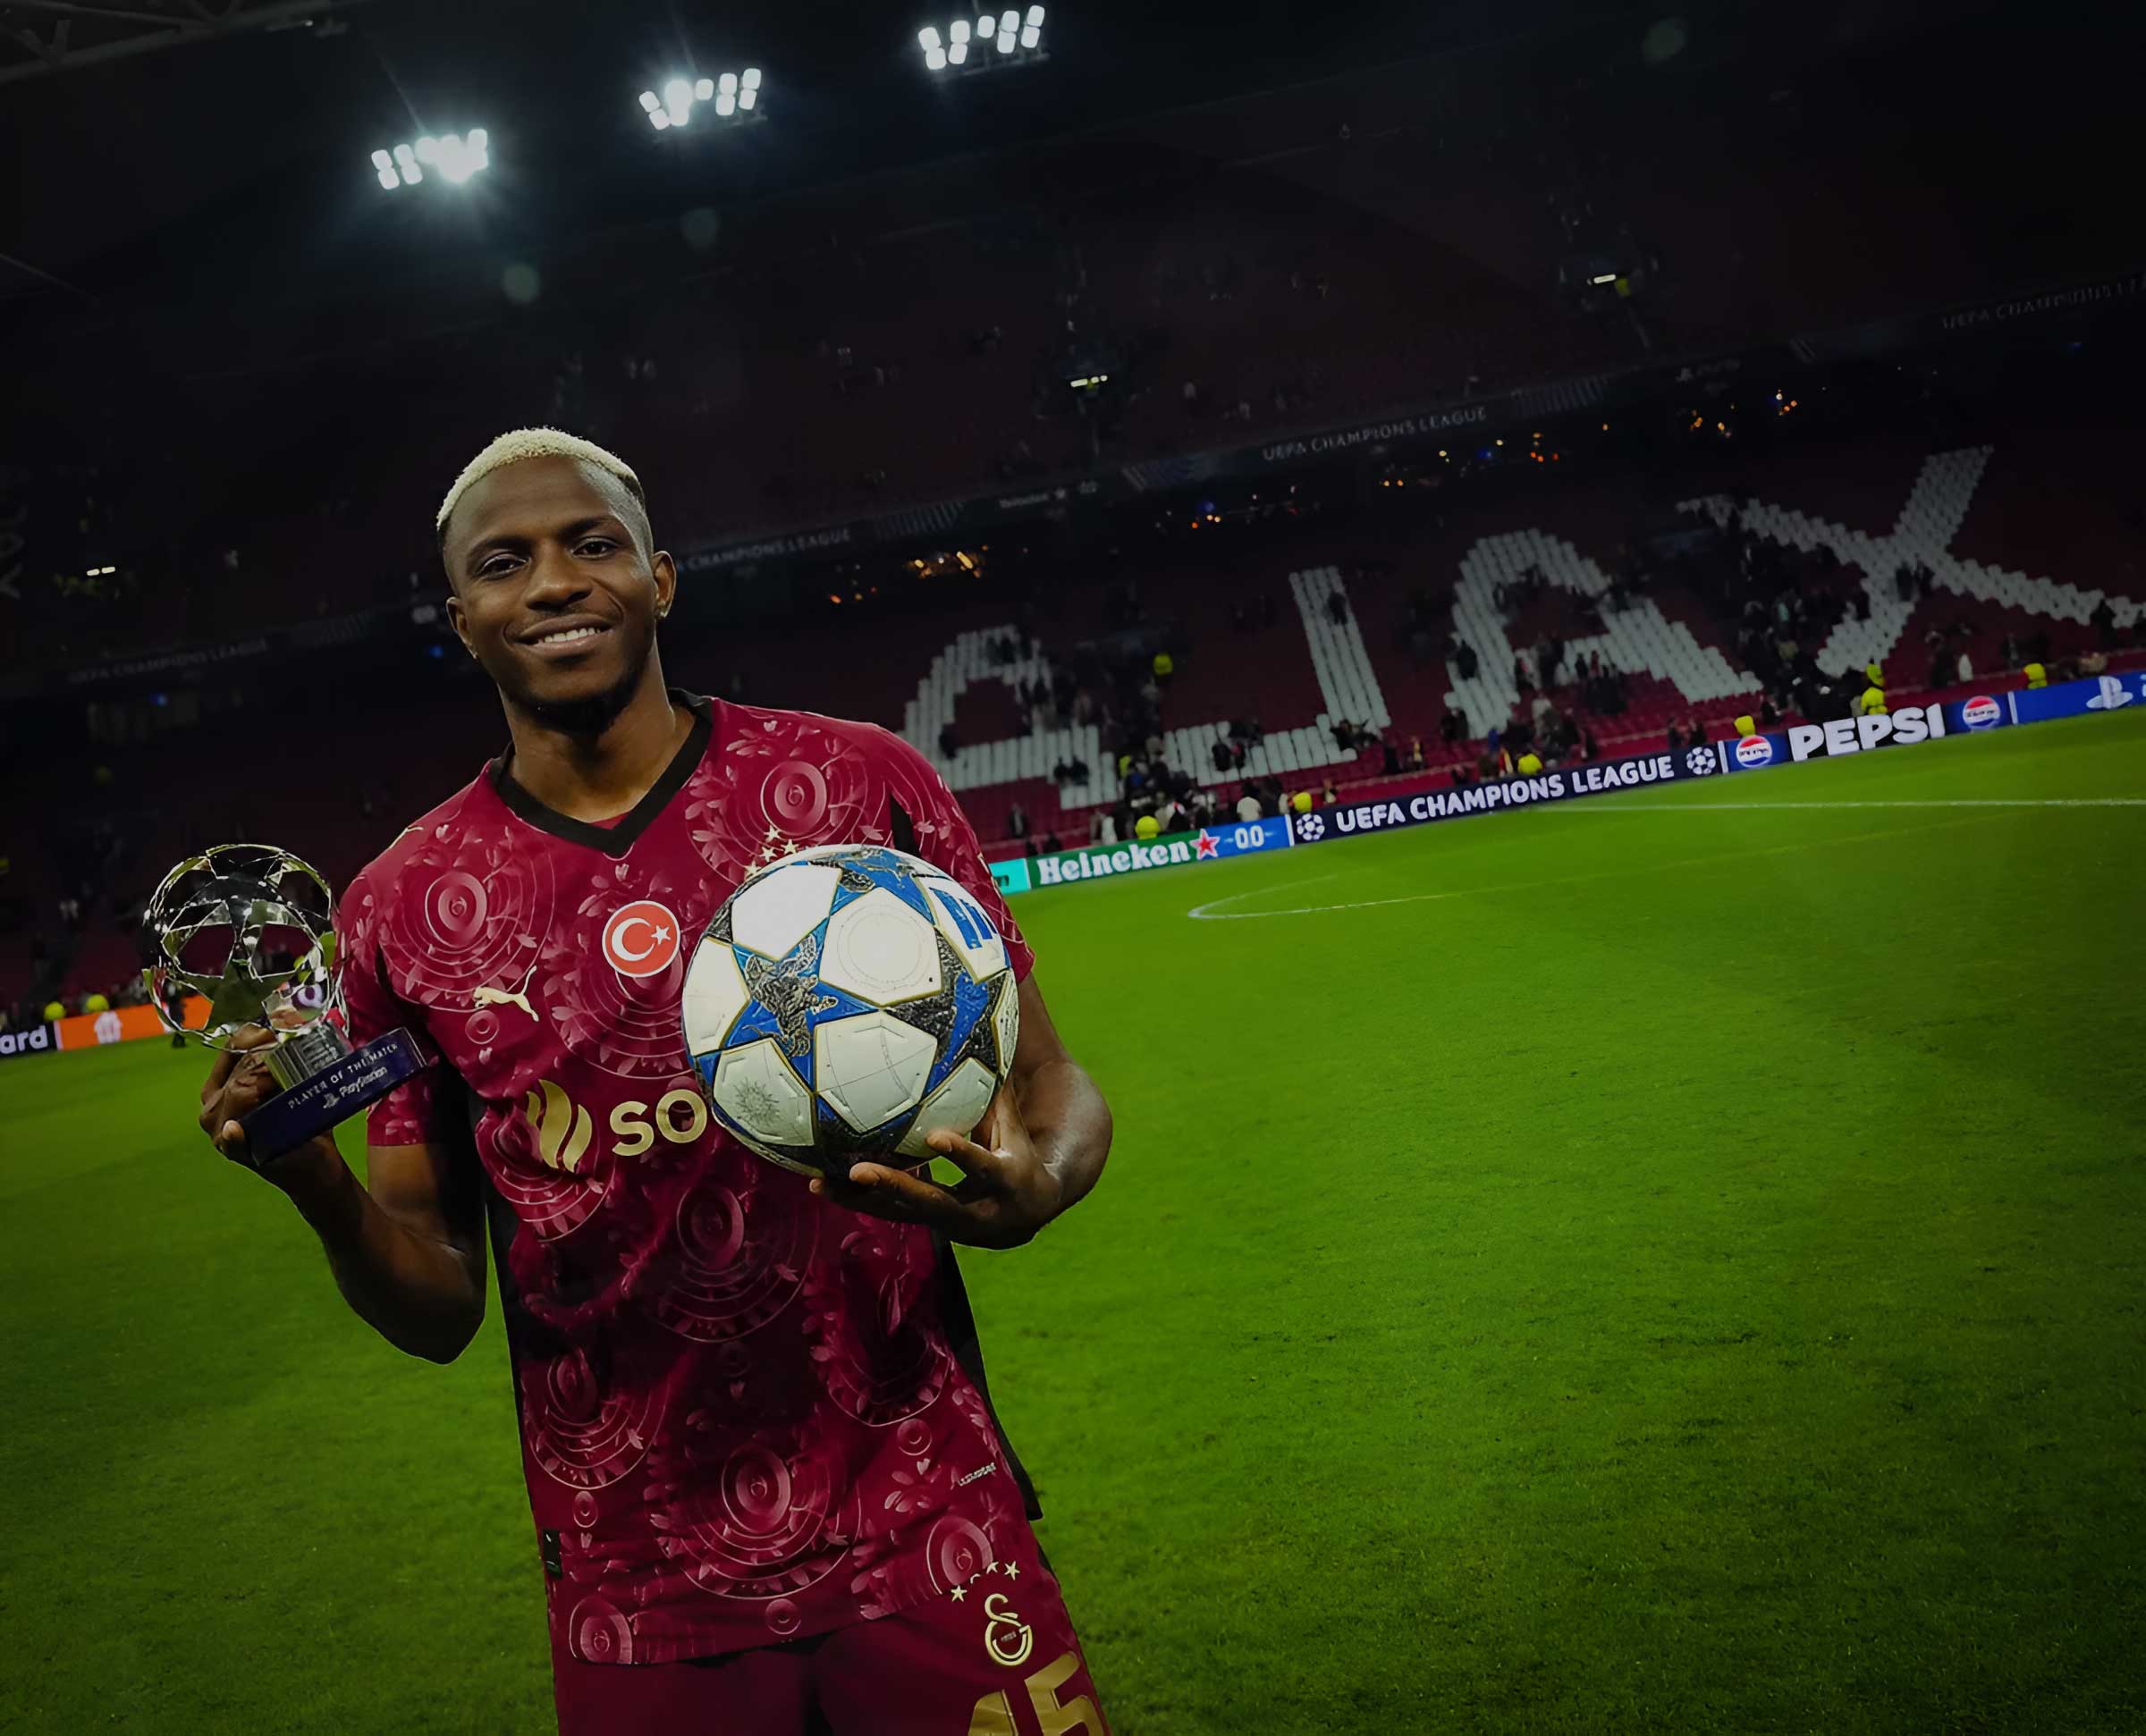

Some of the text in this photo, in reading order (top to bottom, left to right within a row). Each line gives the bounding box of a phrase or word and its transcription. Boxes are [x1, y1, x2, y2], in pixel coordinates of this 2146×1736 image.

[1263, 405, 1488, 461] UEFA CHAMPIONS LEAGUE
[1787, 702, 1947, 763] PEPSI
[1335, 755, 1675, 833] UEFA CHAMPIONS LEAGUE
[1036, 839, 1191, 886] Heineken
[330, 1070, 344, 1084] OF
[609, 1088, 708, 1157] SO
